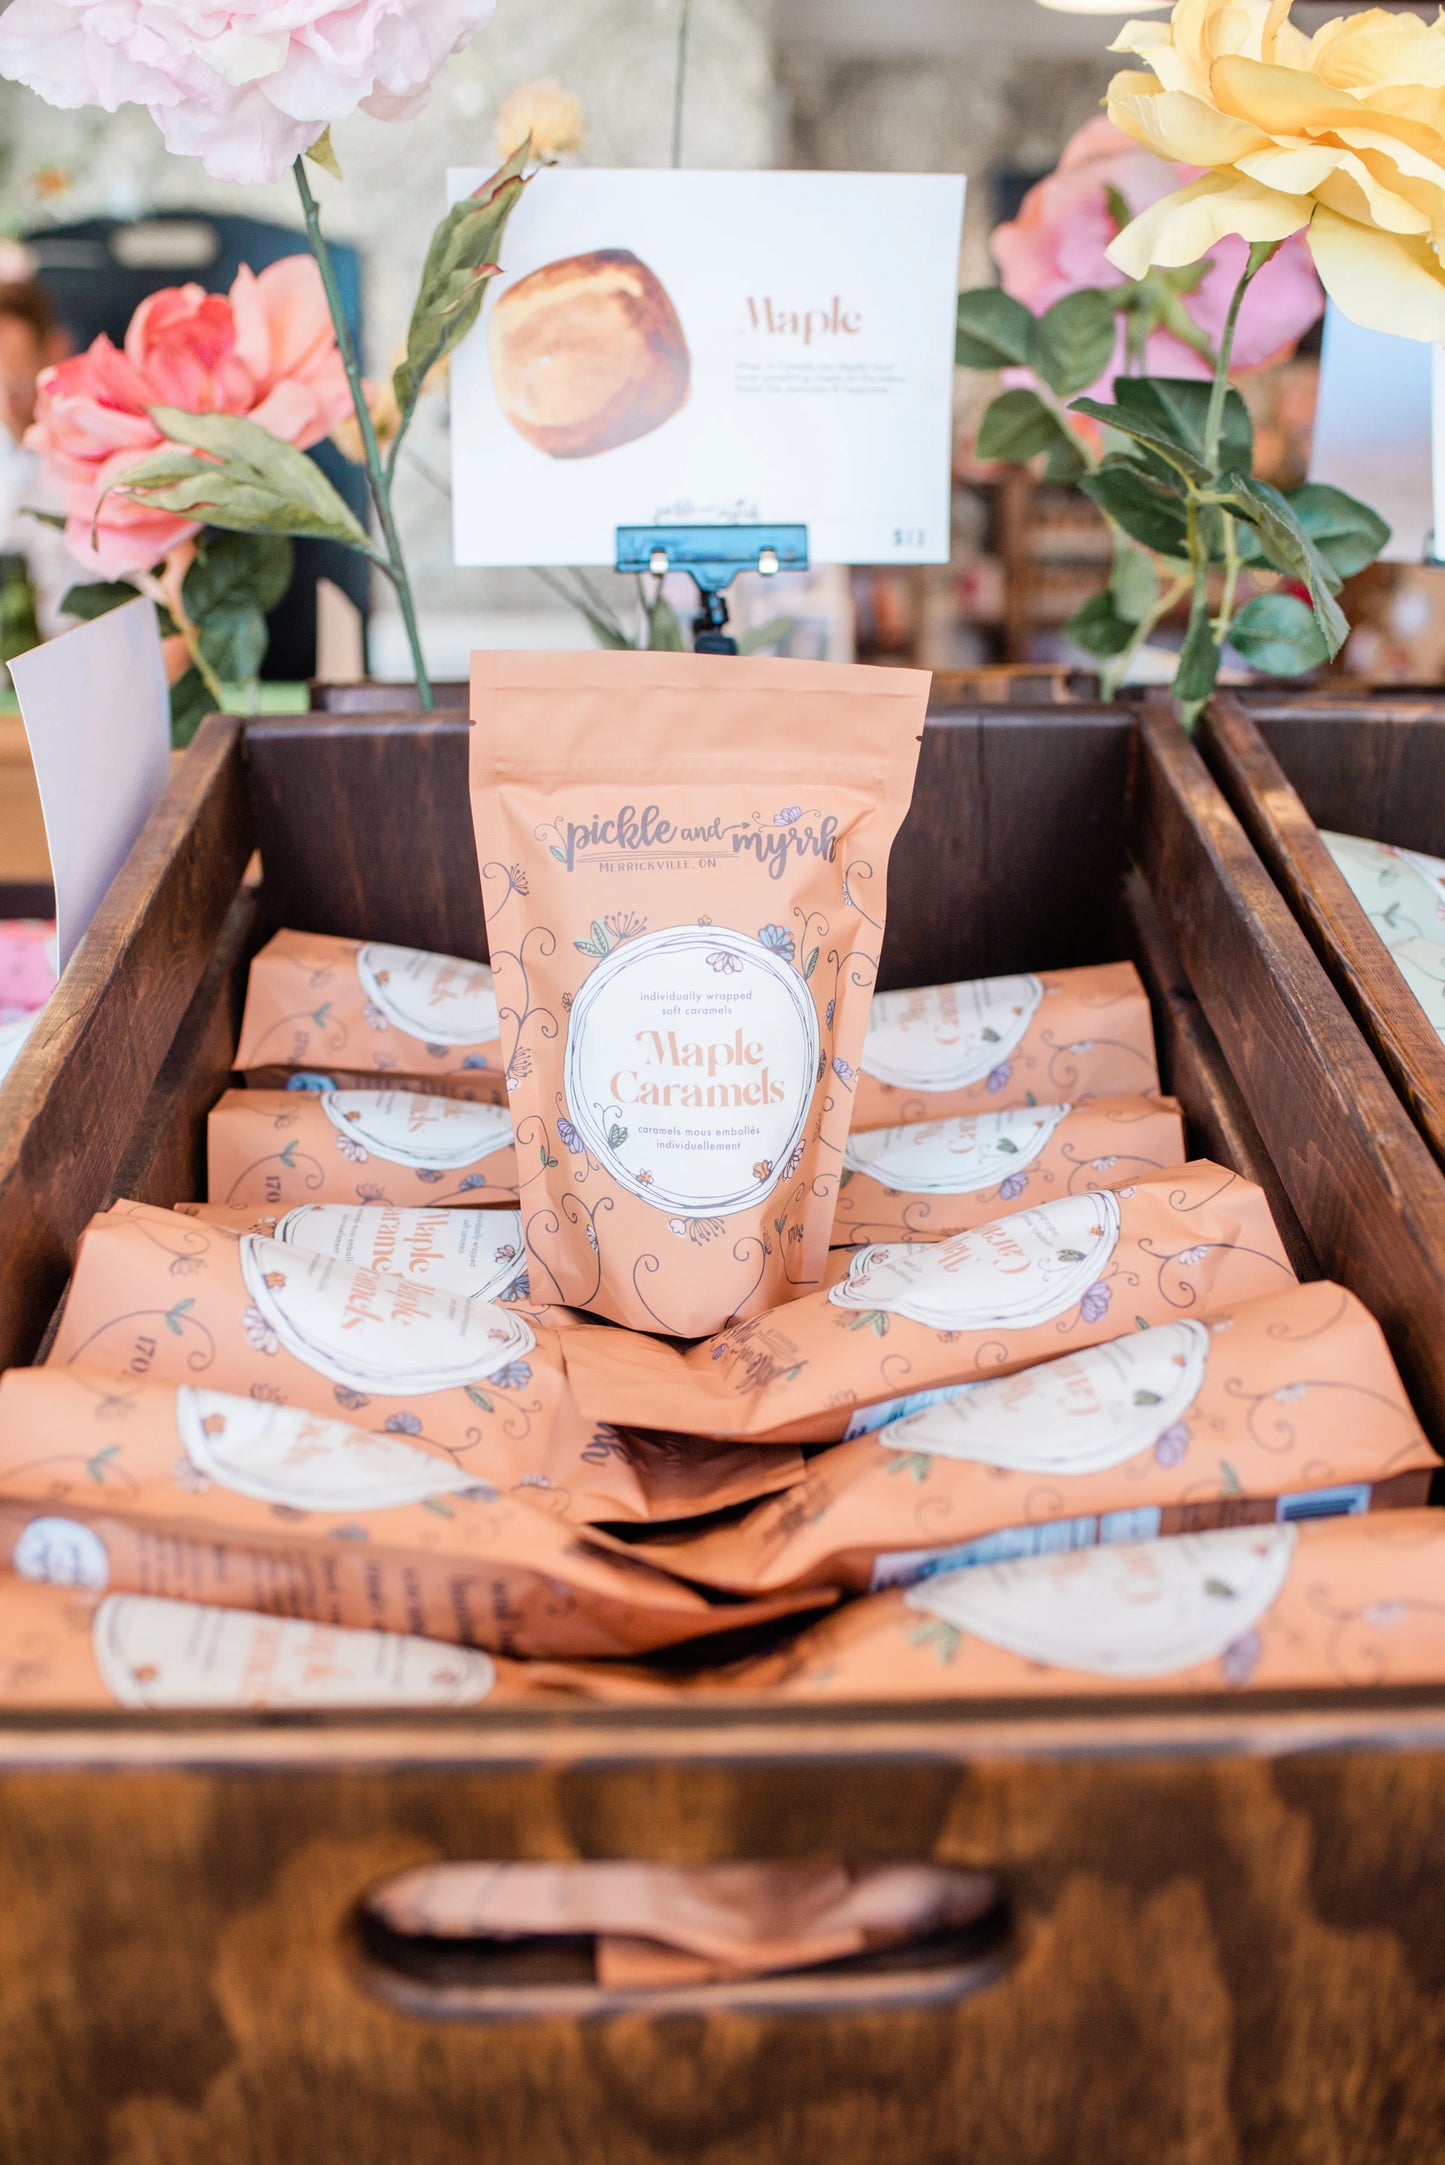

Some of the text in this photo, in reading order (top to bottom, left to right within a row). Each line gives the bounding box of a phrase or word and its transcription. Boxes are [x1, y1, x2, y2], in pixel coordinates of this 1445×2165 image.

[738, 295, 861, 346] Maple
[567, 804, 838, 880] pickle and myrrh
[698, 857, 717, 869] ON
[640, 989, 753, 1003] individually wrapped
[662, 1005, 733, 1016] soft caramels
[635, 1026, 764, 1078] Maple
[610, 1066, 785, 1108] Caramels
[638, 1125, 761, 1137] caramels mous emballés
[656, 1138, 741, 1151] individuellement
[402, 1209, 452, 1273] Maple
